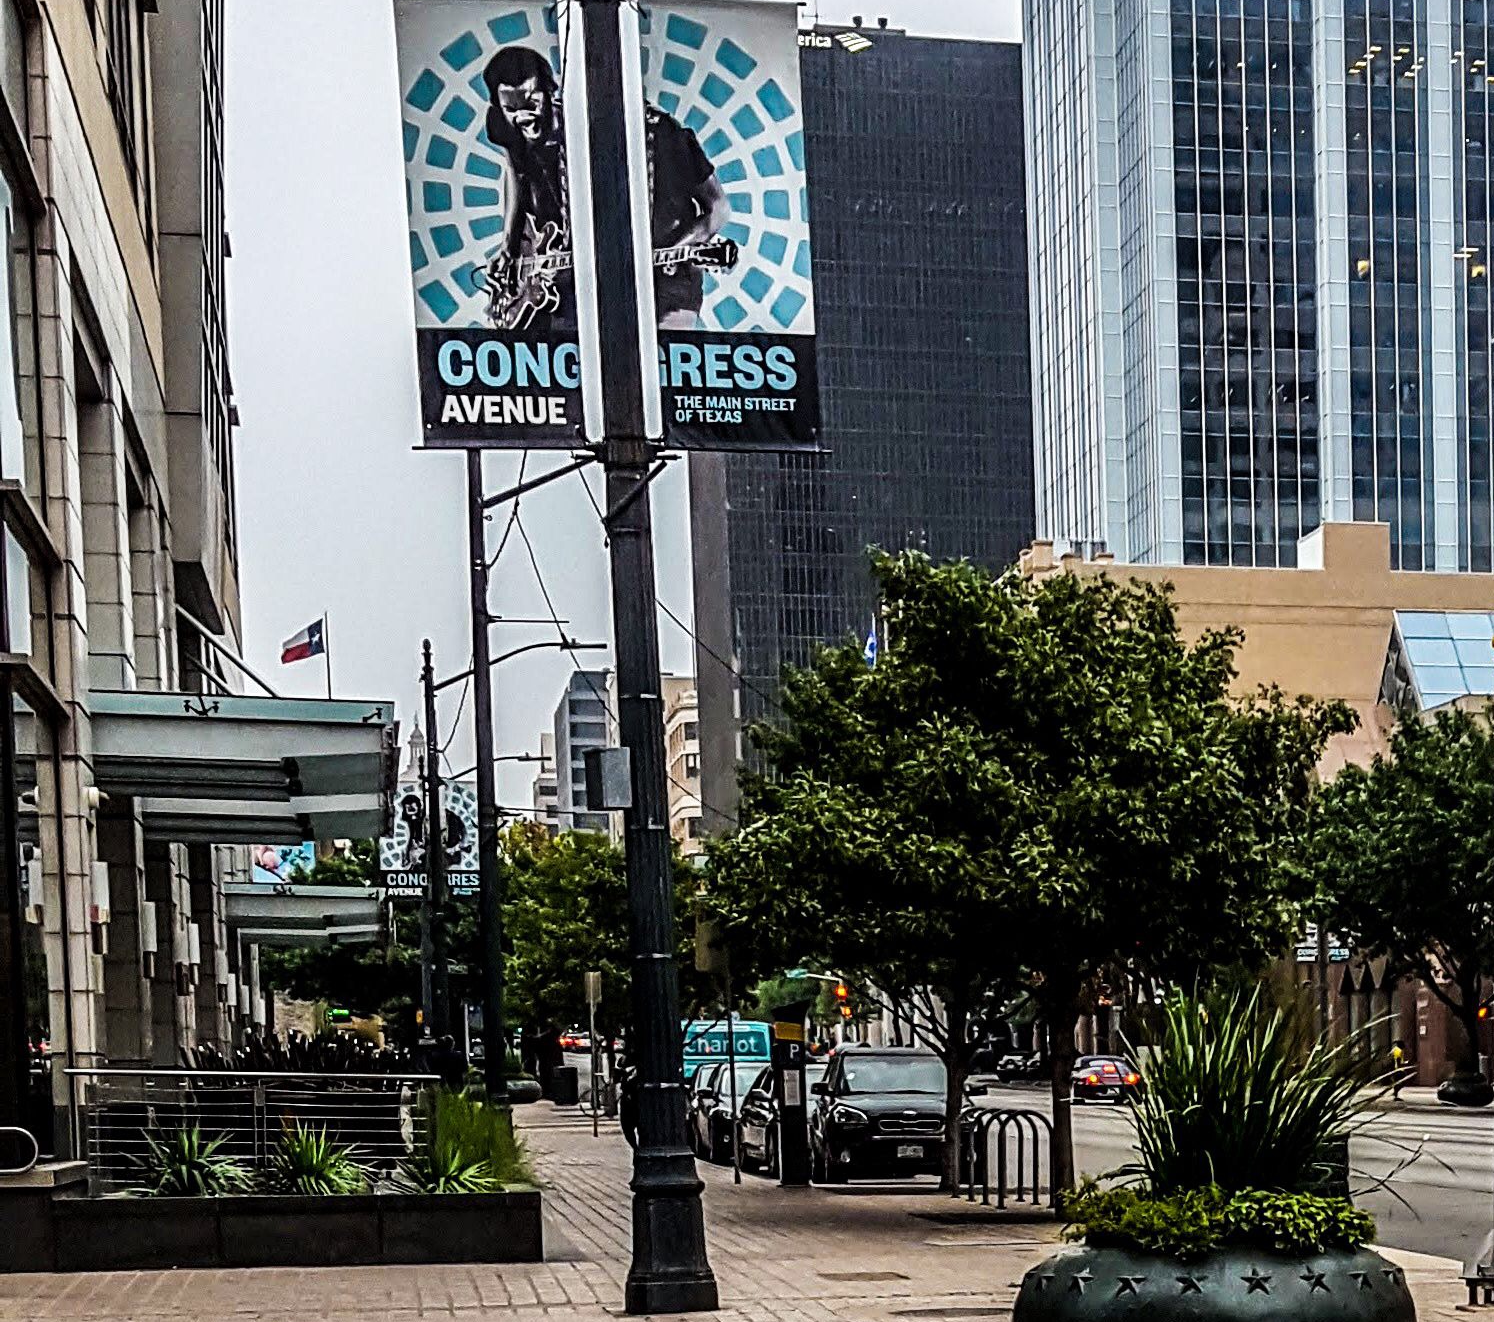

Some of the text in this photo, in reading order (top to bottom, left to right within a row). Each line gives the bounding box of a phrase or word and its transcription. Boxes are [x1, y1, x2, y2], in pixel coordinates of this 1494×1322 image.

[797, 33, 832, 48] erica
[441, 394, 568, 425] AVENUE
[674, 395, 797, 411] THE MAIN STREET
[675, 409, 743, 424] OF TEXAS
[683, 1035, 758, 1053] charot
